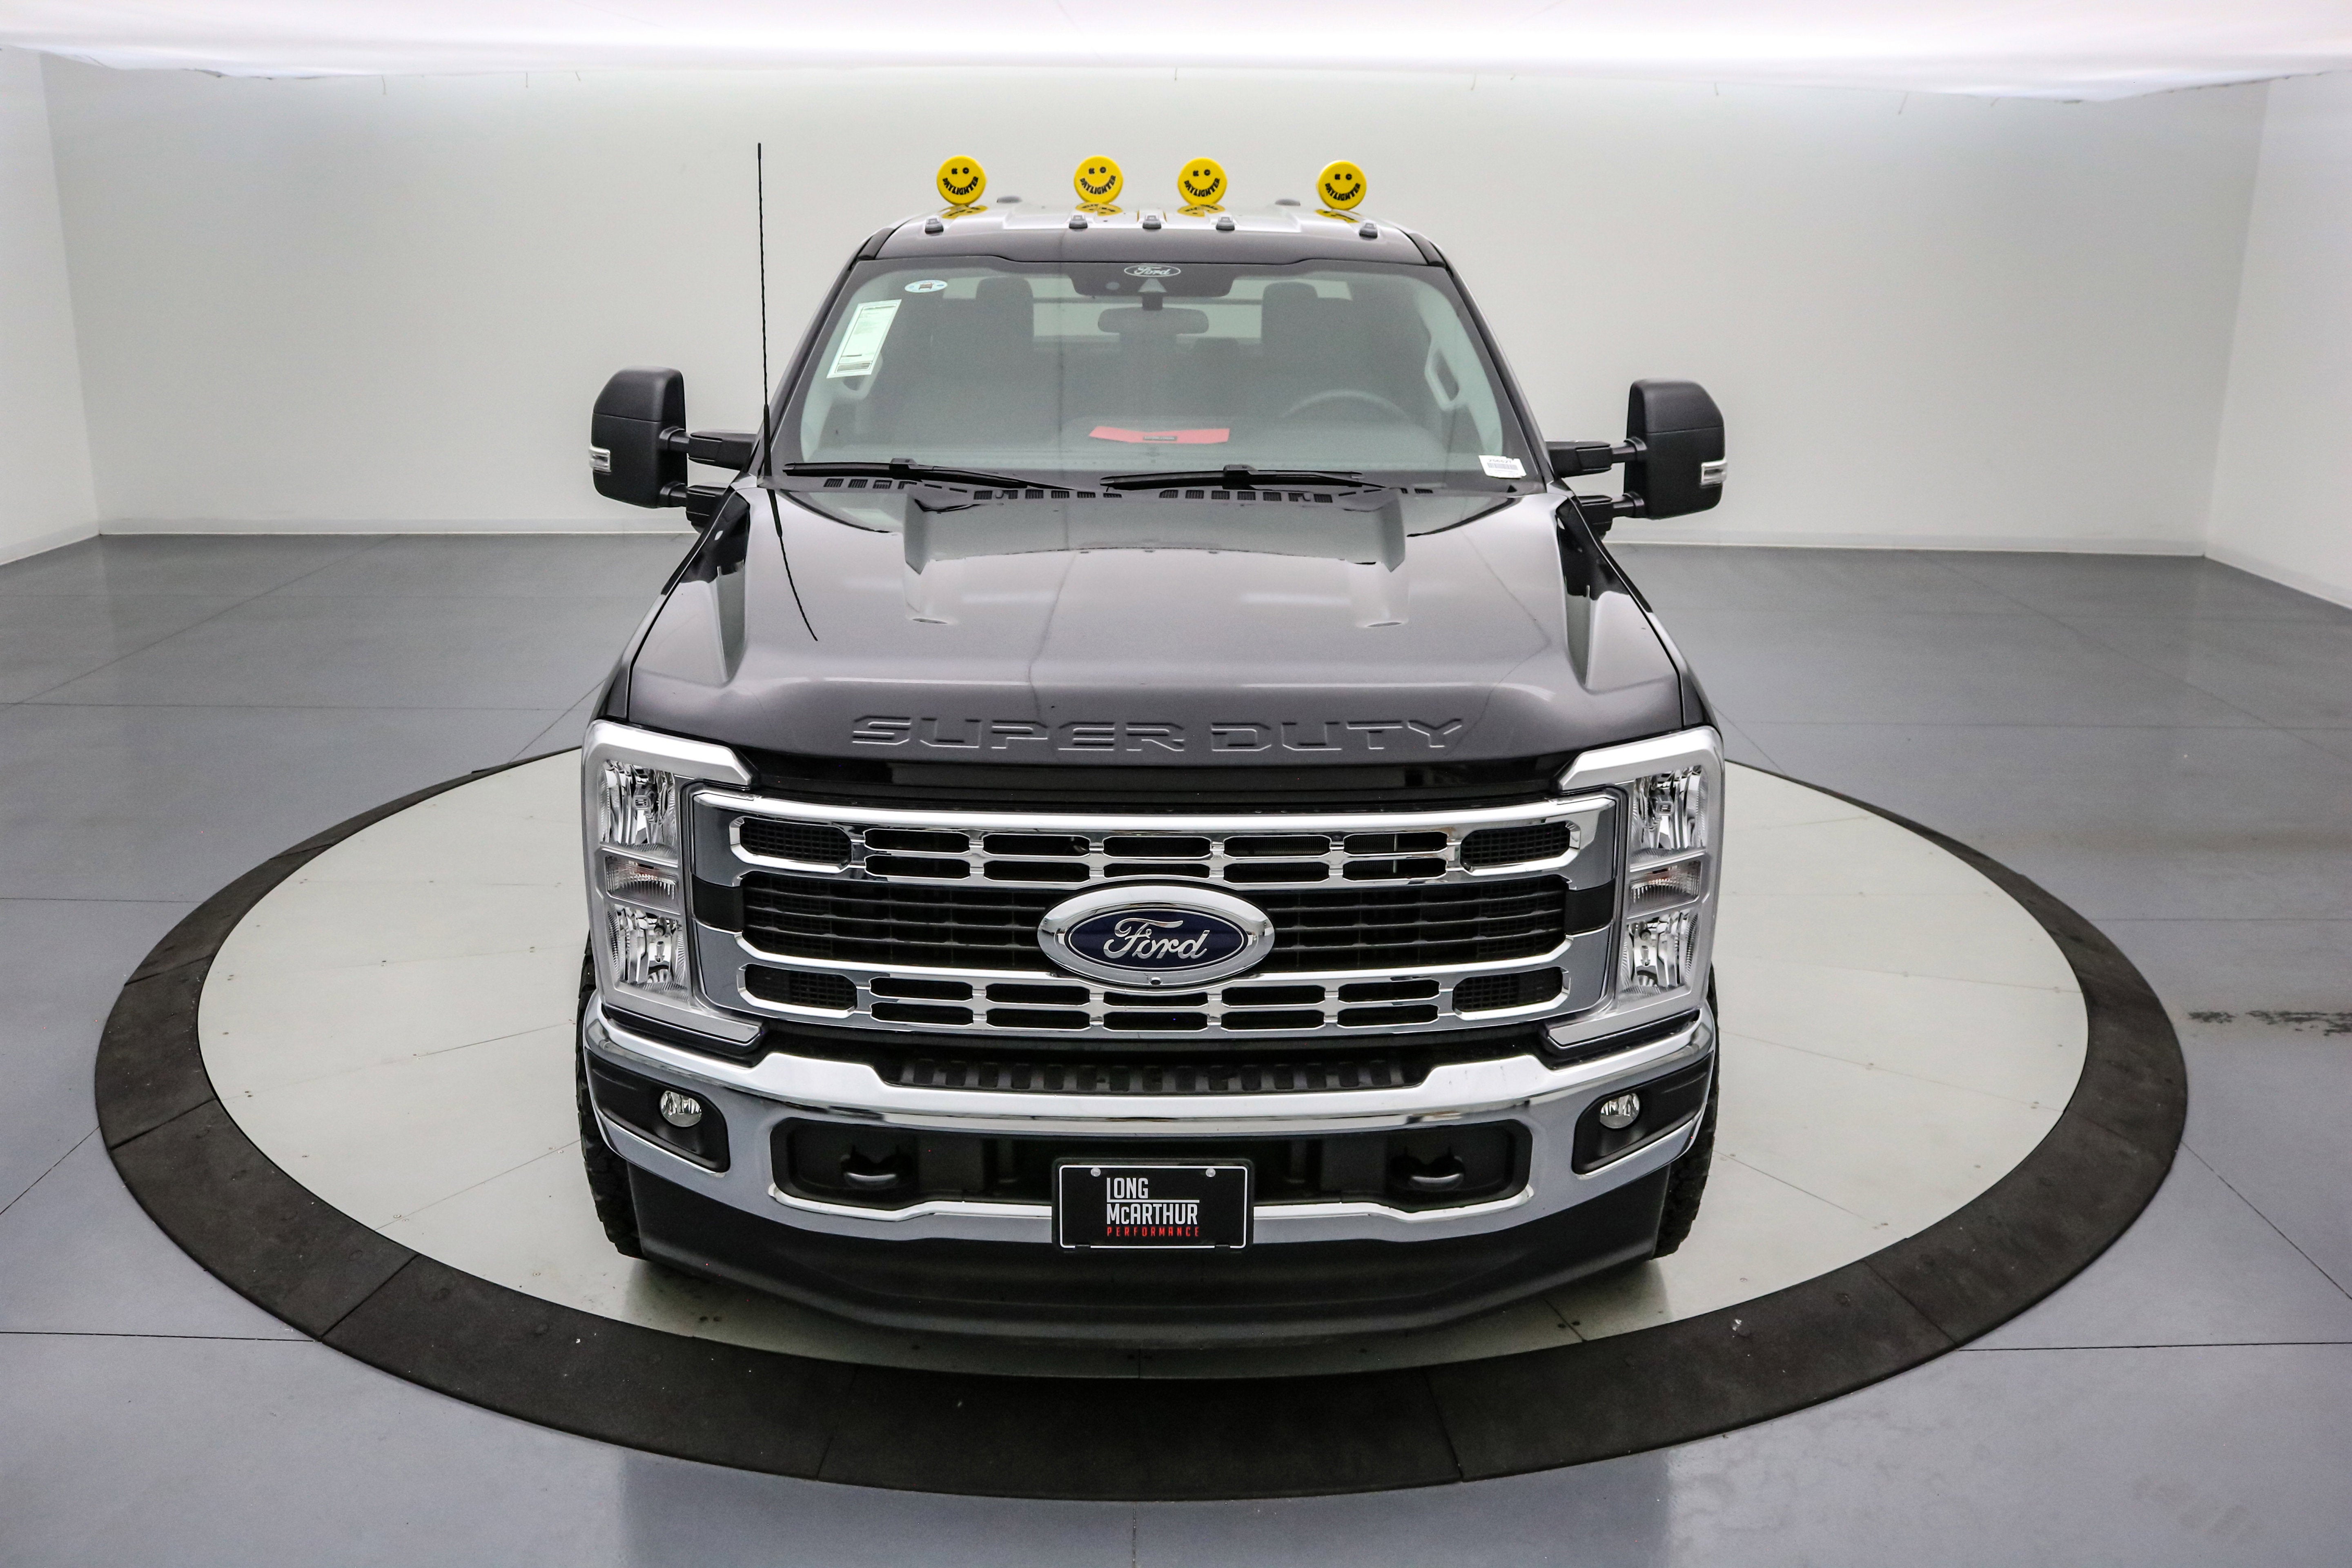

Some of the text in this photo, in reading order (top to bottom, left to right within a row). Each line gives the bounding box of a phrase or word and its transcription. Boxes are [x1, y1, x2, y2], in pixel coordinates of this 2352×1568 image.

[1134, 266, 1172, 276] Ford
[852, 715, 1462, 751] SUPER DUTY
[1103, 918, 1210, 959] Ford
[1106, 1177, 1149, 1203] LONG
[1107, 1226, 1200, 1237] PERFORMANCE
